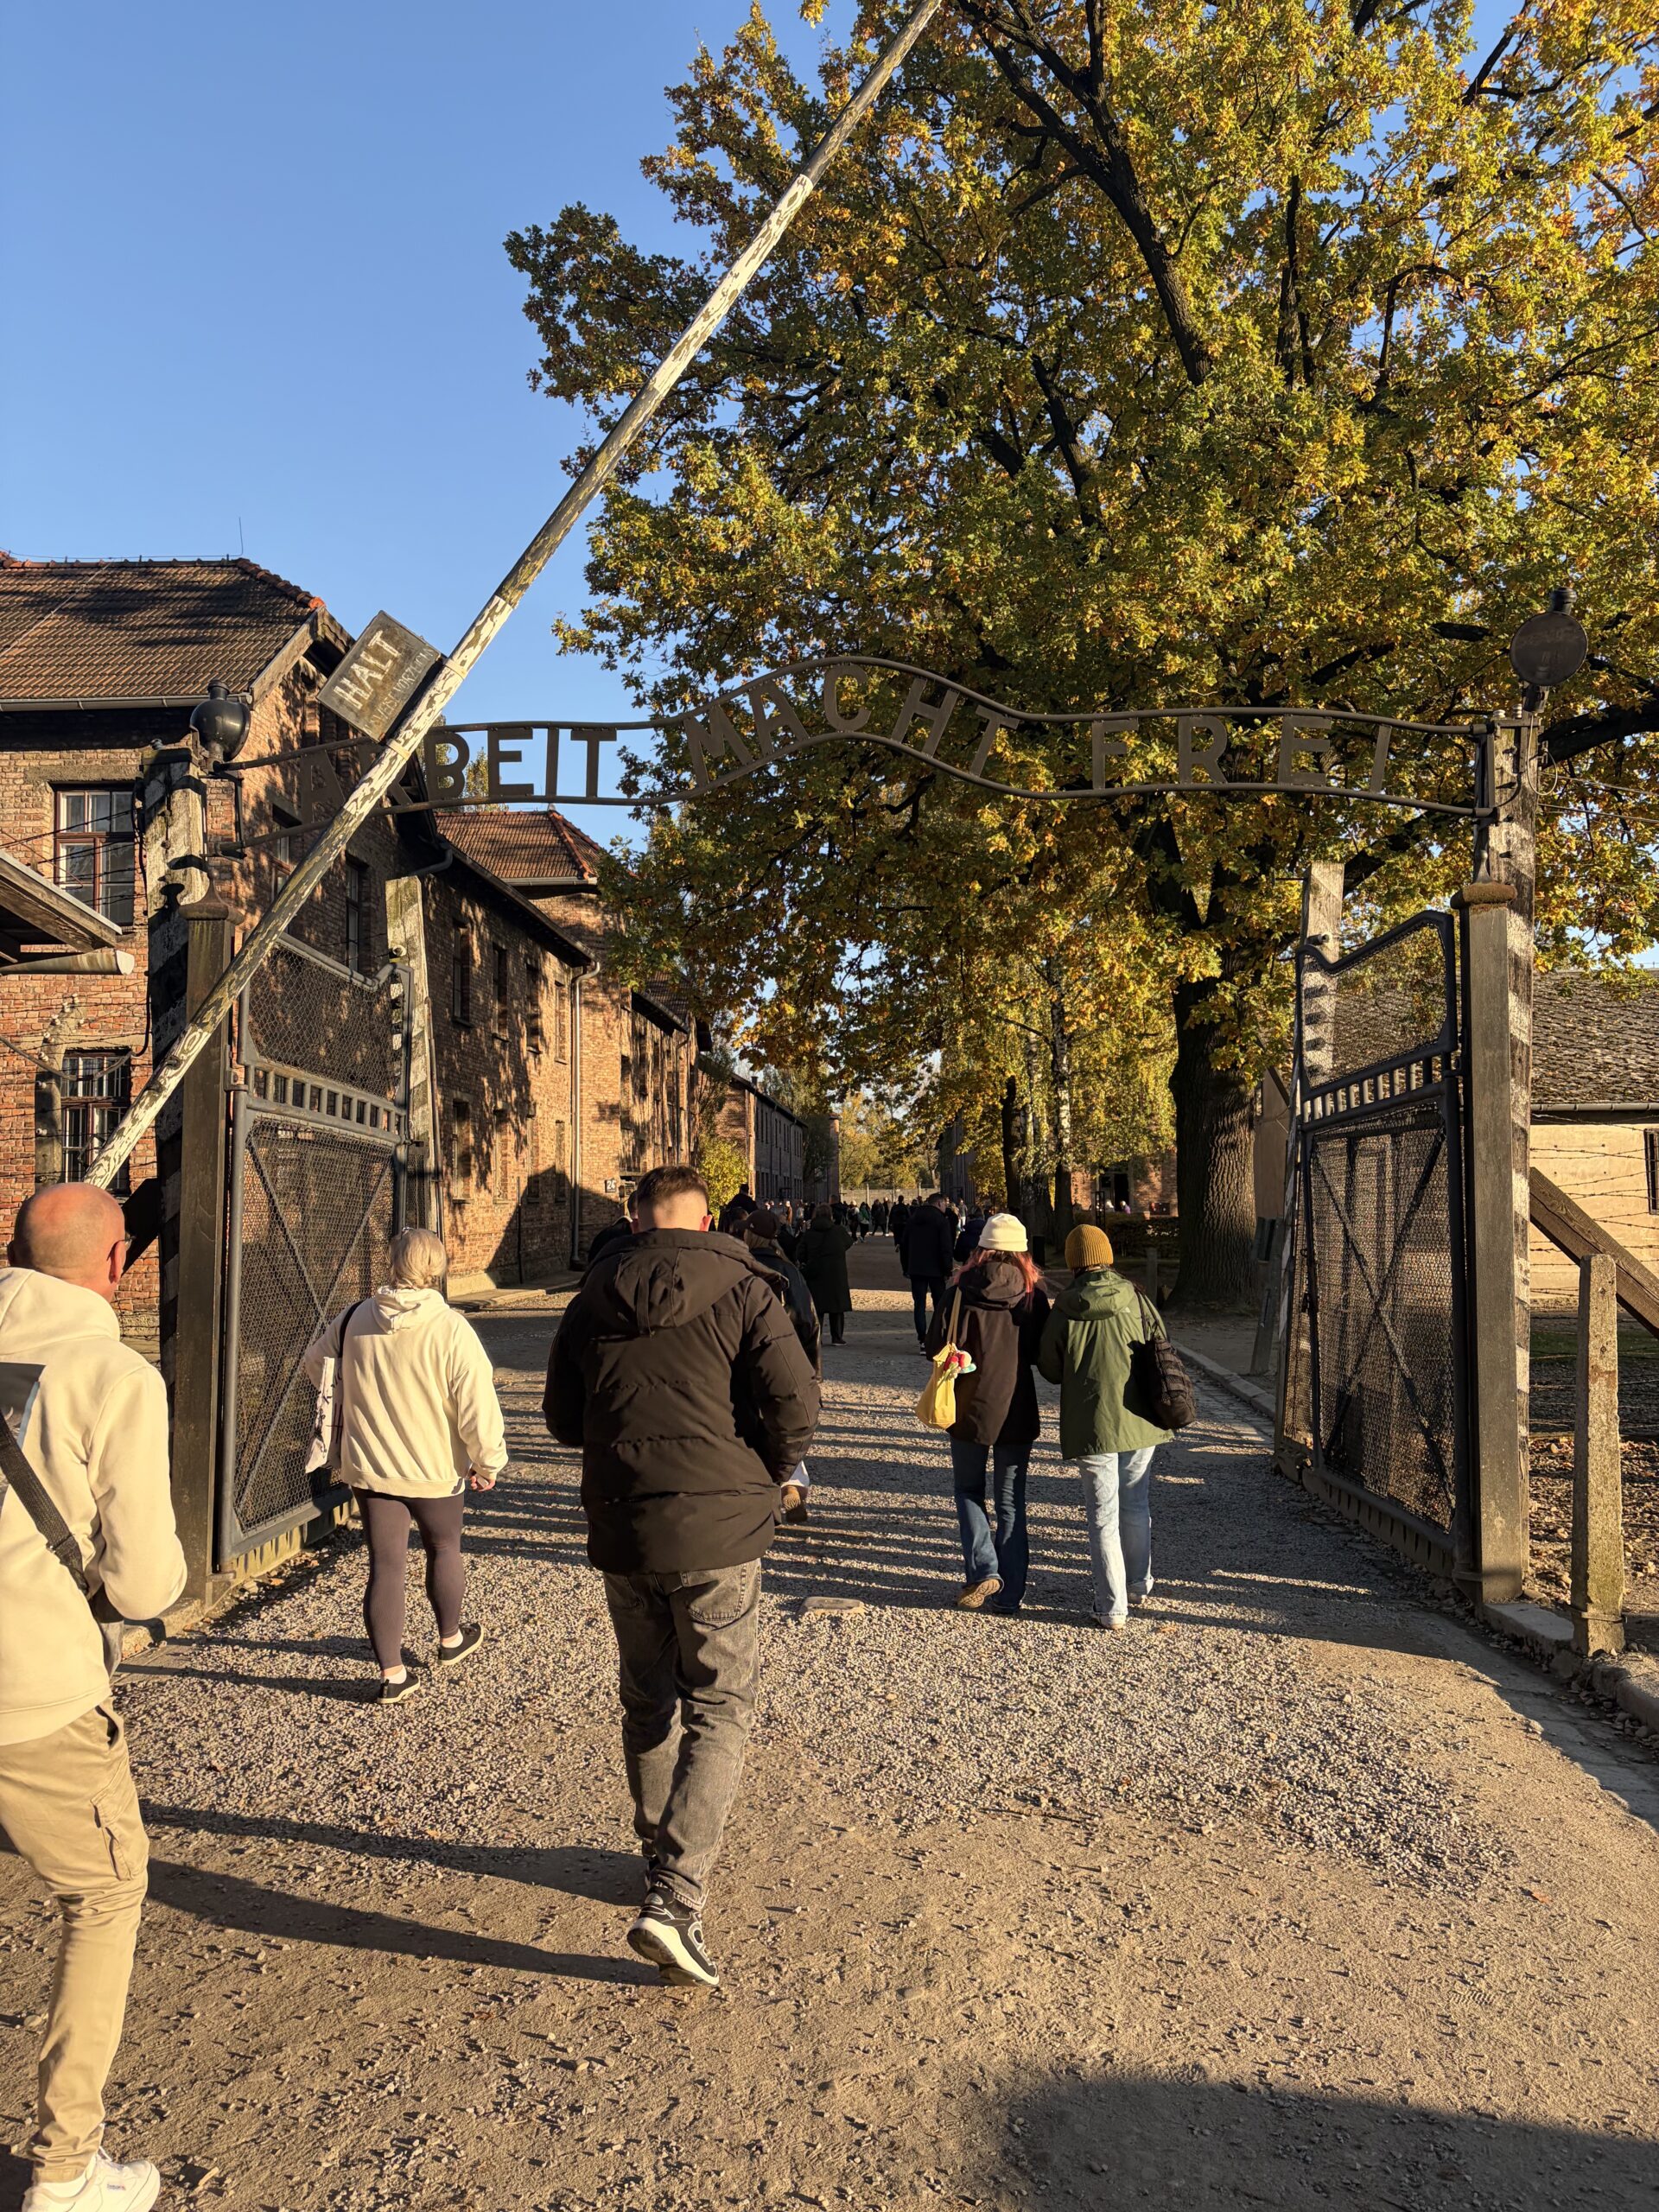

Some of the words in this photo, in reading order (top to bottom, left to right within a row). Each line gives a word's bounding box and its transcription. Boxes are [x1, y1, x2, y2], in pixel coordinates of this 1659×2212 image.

[334, 630, 401, 710] HALT
[683, 664, 1020, 788] MACHT
[1091, 715, 1393, 792] FREI
